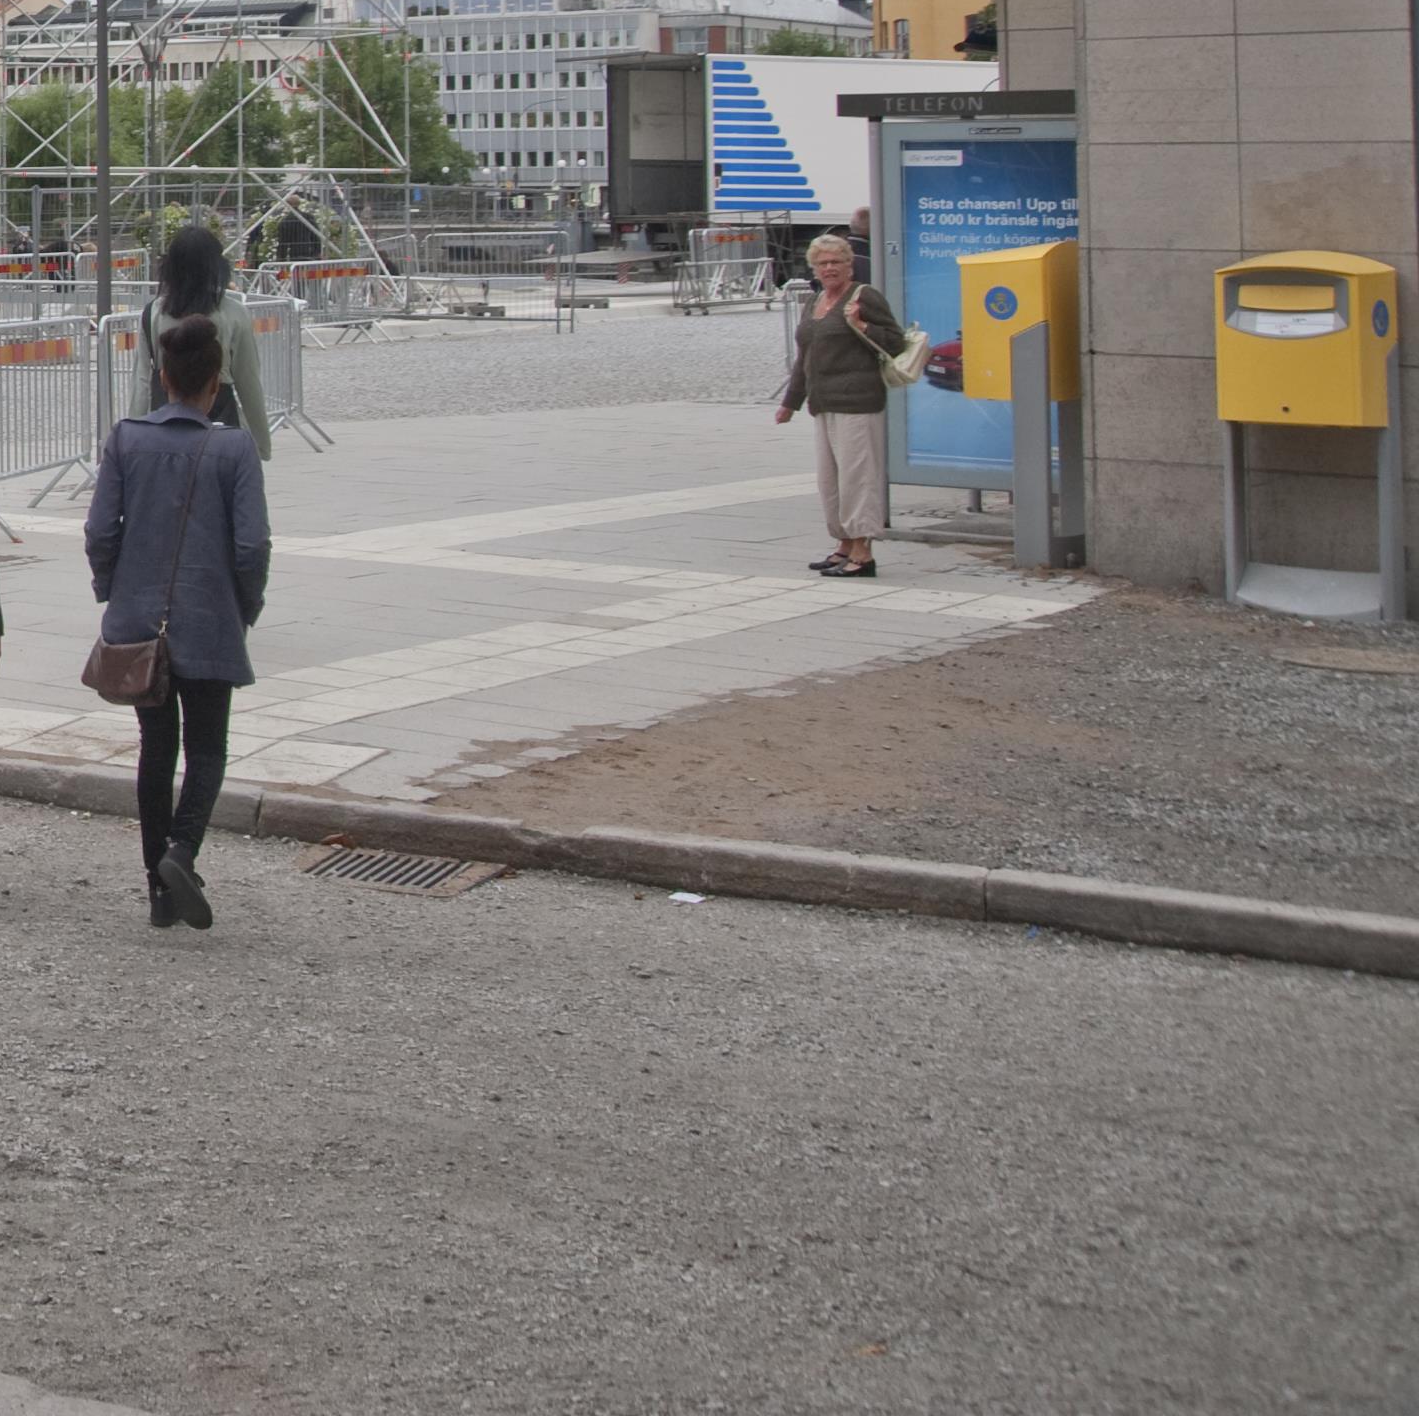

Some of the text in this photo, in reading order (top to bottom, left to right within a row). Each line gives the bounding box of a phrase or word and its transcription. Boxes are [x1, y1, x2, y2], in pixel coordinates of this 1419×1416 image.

[883, 95, 984, 113] TELEFON
[918, 197, 954, 210] Sista
[957, 196, 1022, 211] chansen!
[1026, 197, 1058, 214] Upp
[919, 213, 937, 225] 12
[939, 213, 964, 226] 000
[968, 214, 983, 226] kr
[985, 213, 1039, 227] bränsle
[919, 232, 956, 244] Gäller
[960, 232, 980, 244] när
[984, 232, 1001, 245] du
[1004, 233, 1041, 247] köper
